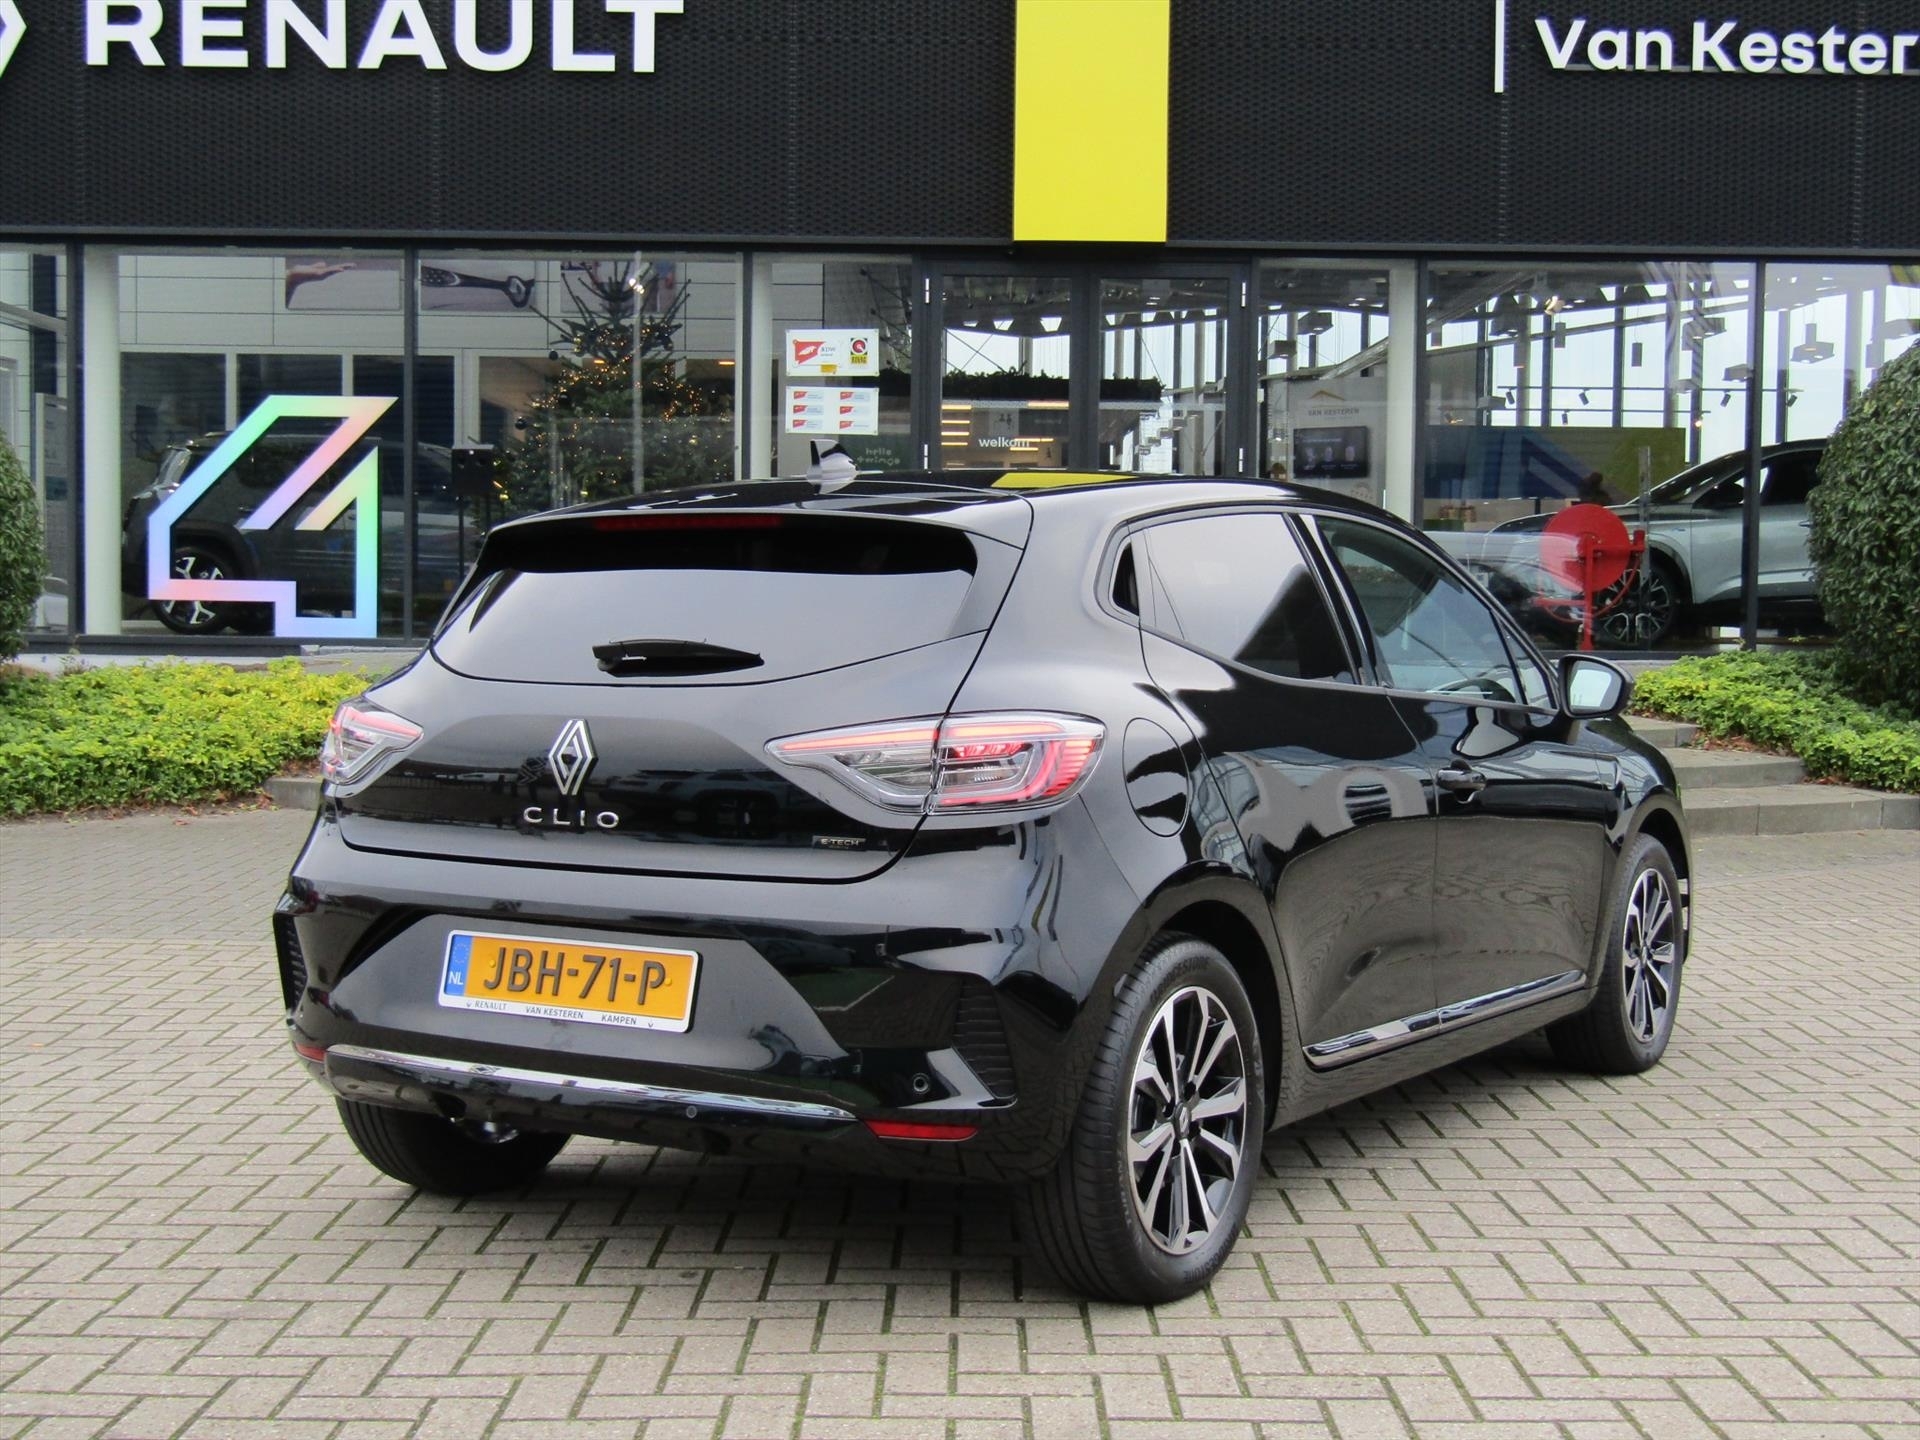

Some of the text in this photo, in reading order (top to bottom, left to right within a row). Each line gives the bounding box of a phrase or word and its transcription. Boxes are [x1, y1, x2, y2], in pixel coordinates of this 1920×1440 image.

[86, 0, 685, 72] RENAULT
[1534, 18, 1673, 71] Van
[978, 436, 1030, 448] welkom
[523, 806, 620, 829] CLIO
[449, 970, 464, 986] NL
[483, 946, 666, 1006] JBH-71-P
[474, 1000, 637, 1026] RENAULT VAN KESTEREN KAMPEN
